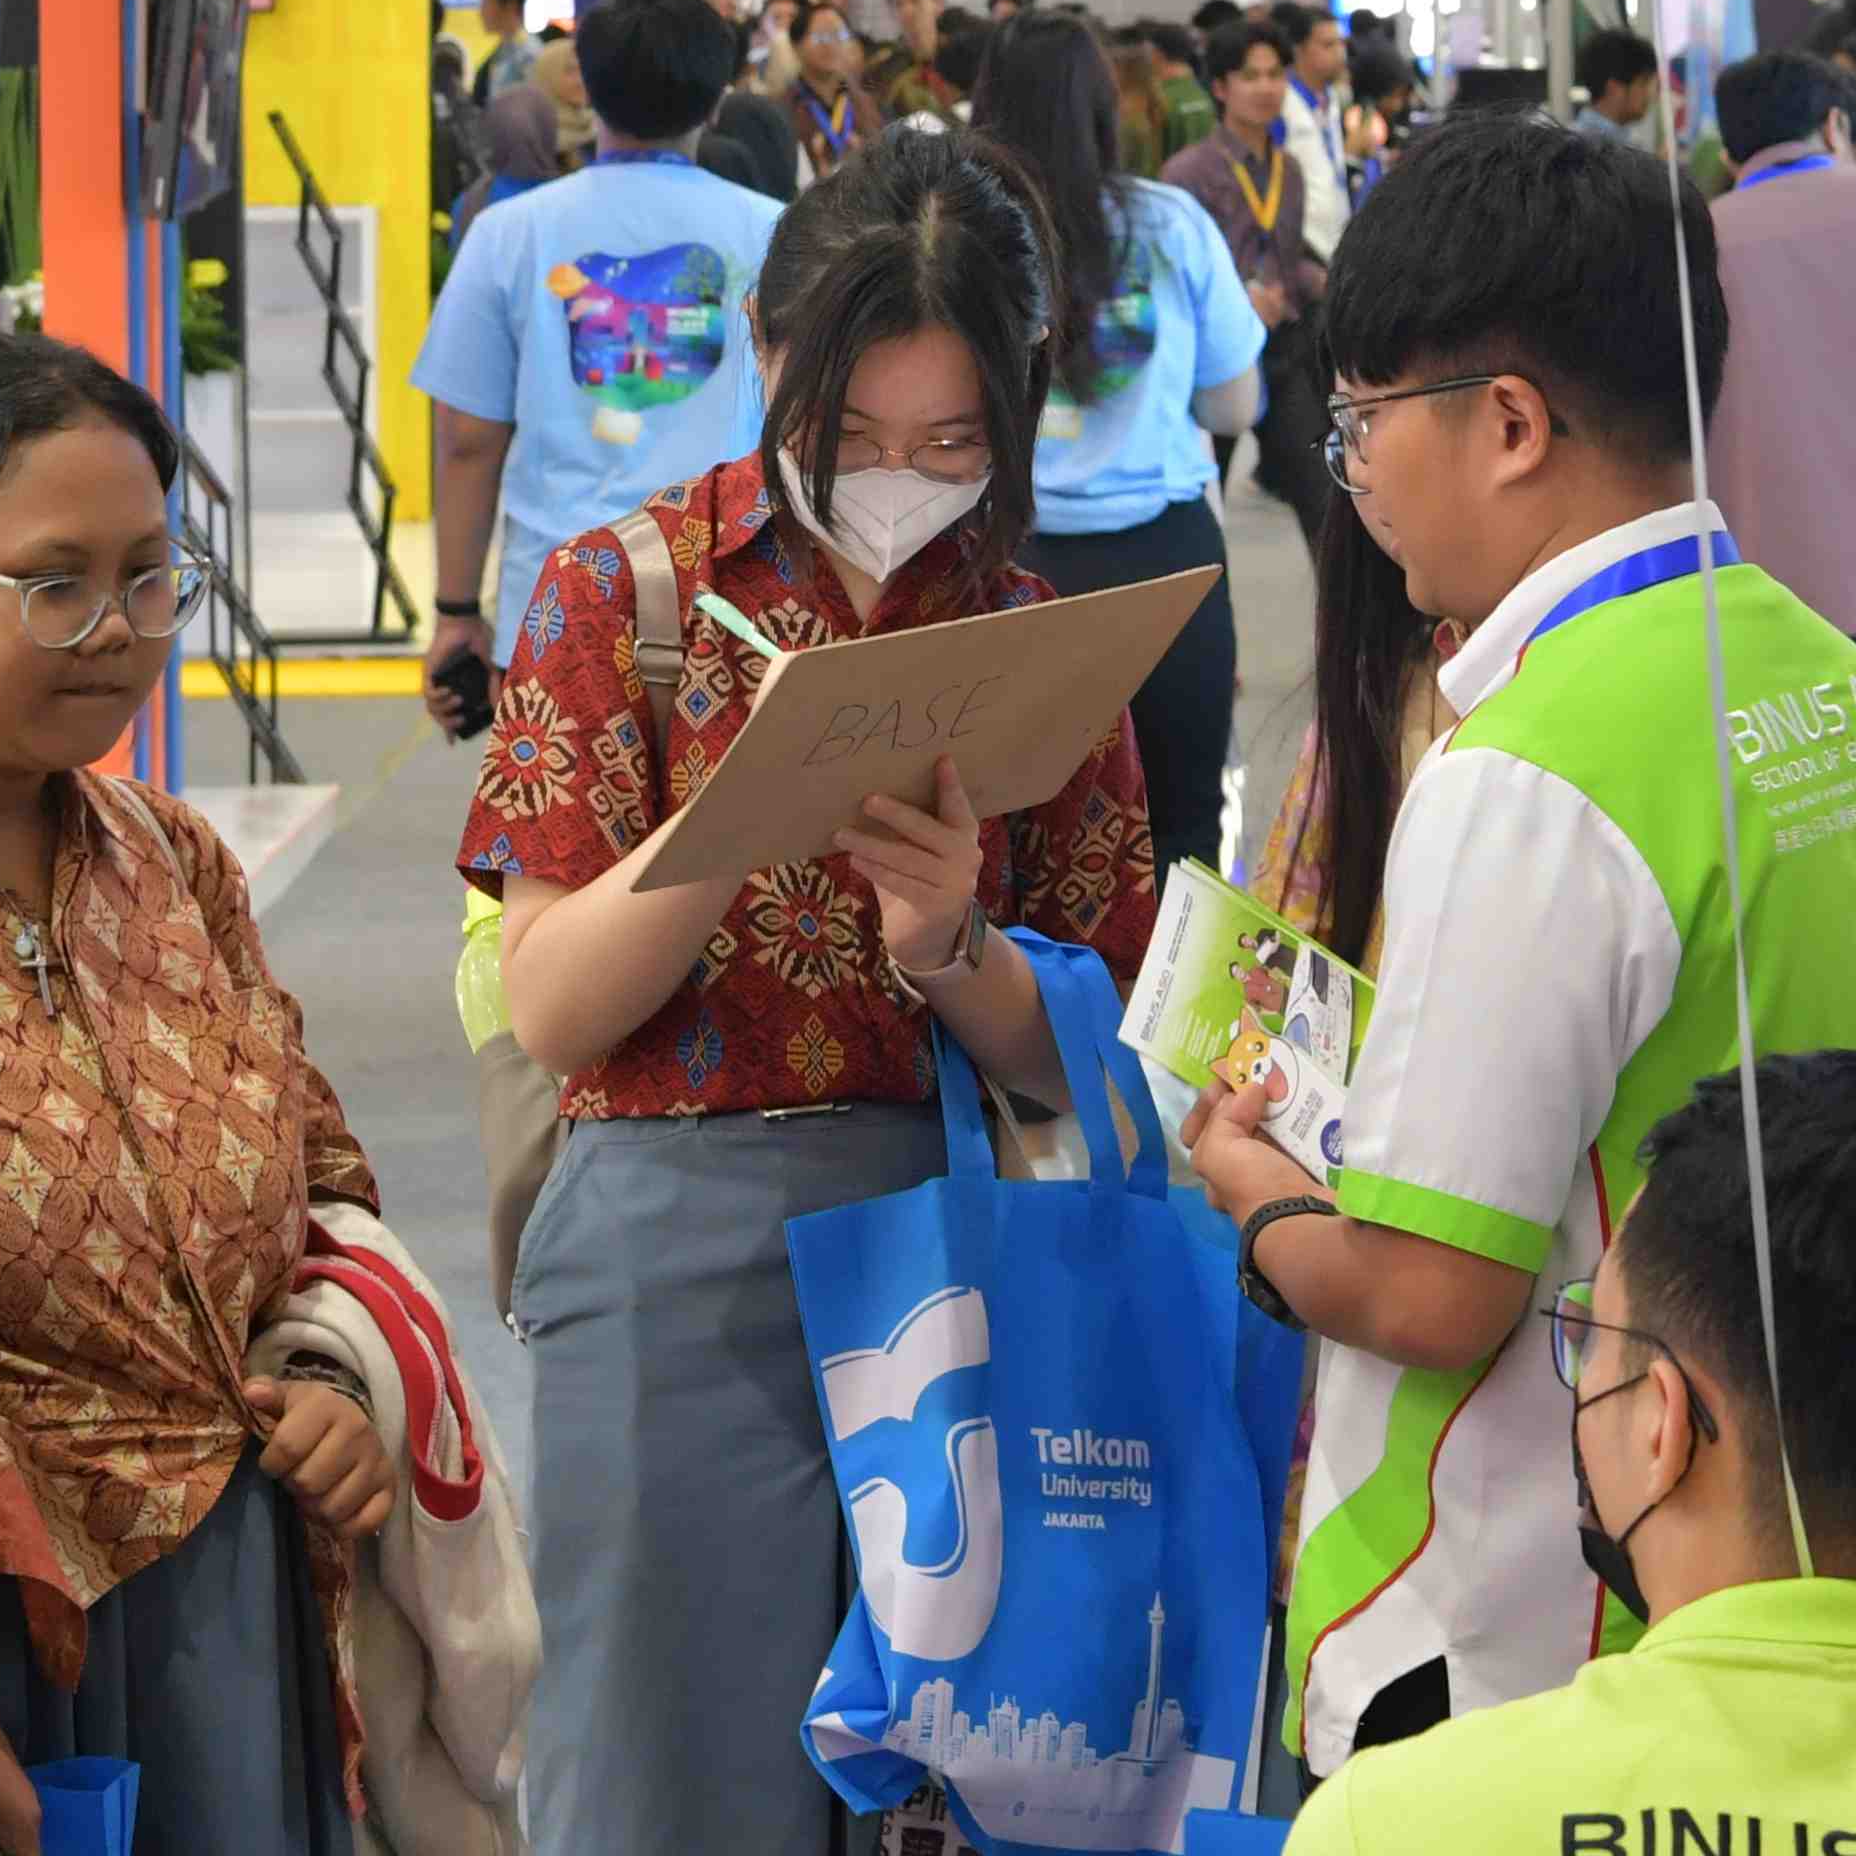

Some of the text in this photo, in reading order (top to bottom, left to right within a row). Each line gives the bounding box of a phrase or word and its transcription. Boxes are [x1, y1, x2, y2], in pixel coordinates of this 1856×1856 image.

[801, 674, 1004, 767] BASE
[1724, 683, 1846, 765] BINUS
[1750, 757, 1823, 793] SCHOOL
[1823, 746, 1841, 772] OF
[1030, 1427, 1150, 1469] Telkom
[1041, 1473, 1152, 1507] University
[1042, 1511, 1106, 1529] JAKARTA
